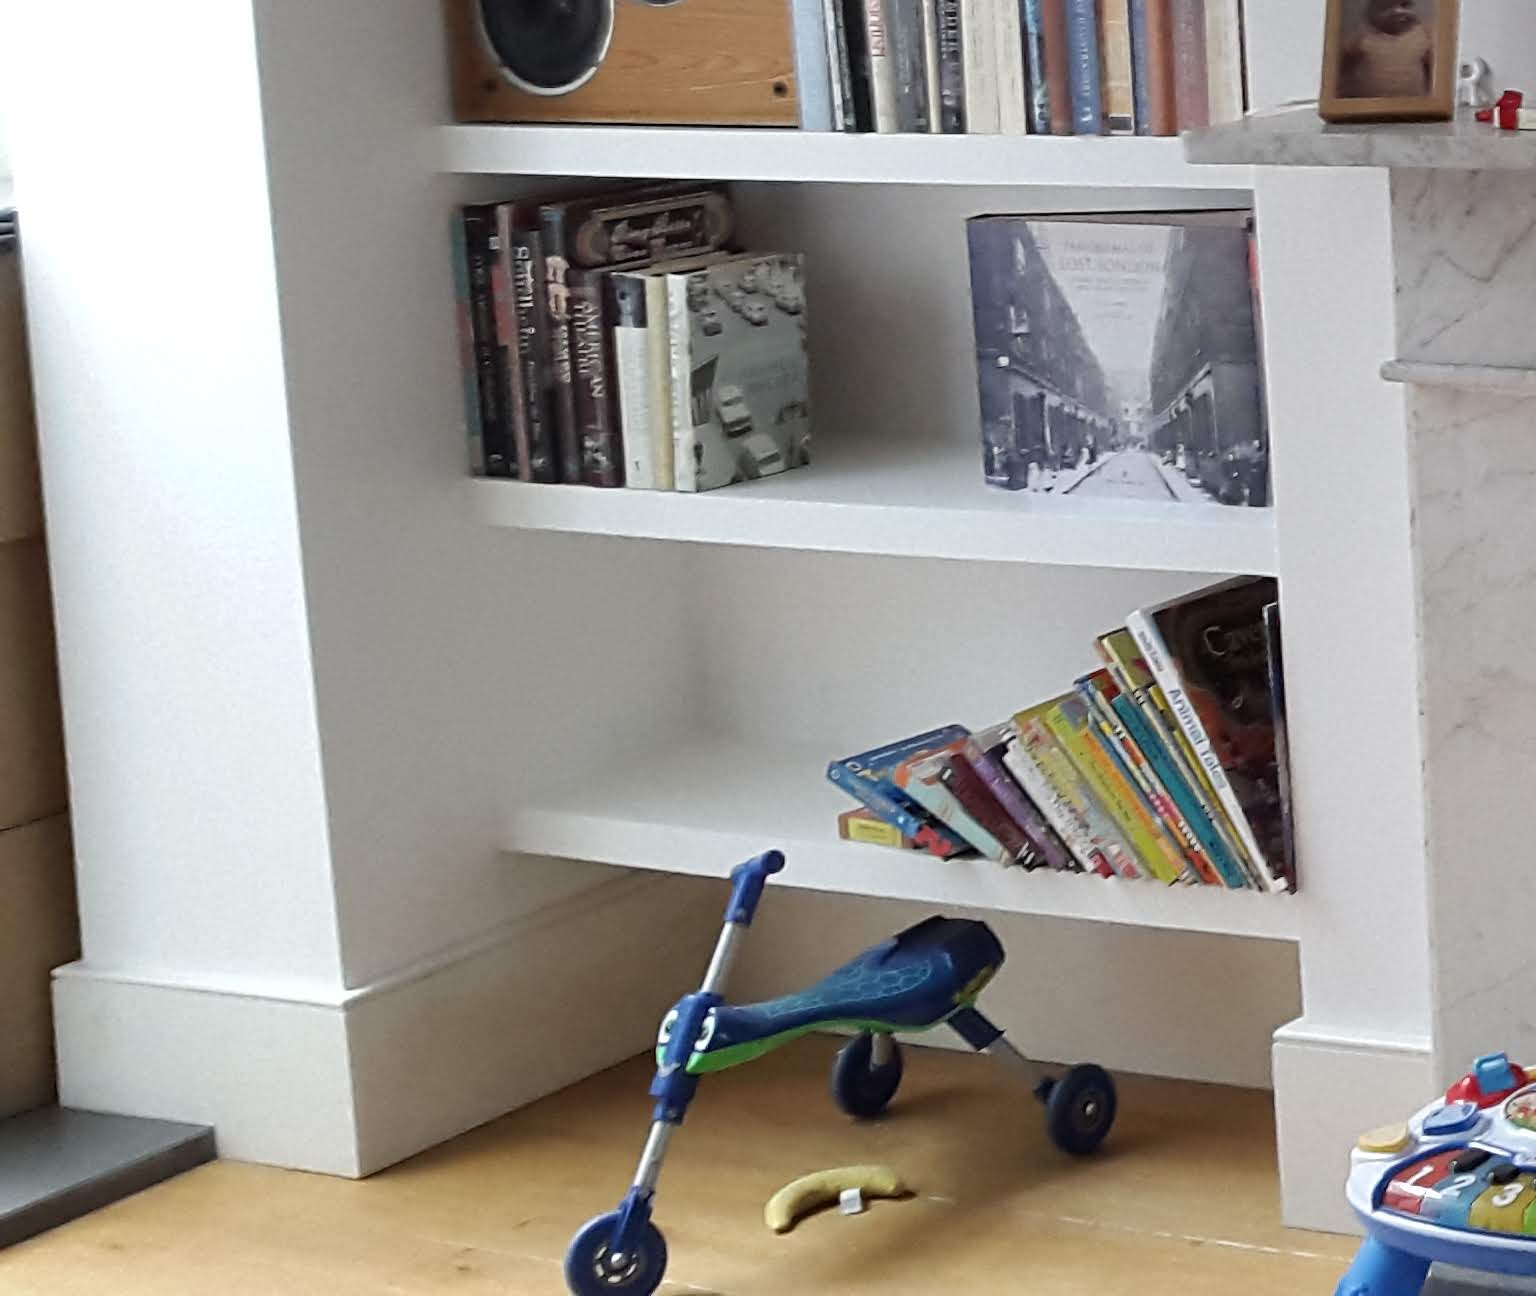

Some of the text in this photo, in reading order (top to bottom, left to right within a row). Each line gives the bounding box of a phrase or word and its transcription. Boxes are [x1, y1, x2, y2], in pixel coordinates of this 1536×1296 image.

[583, 301, 605, 399] AMERICAN
[1167, 688, 1207, 747] Animal
[1445, 1174, 1478, 1198] 2
[1492, 1182, 1524, 1209] 3
